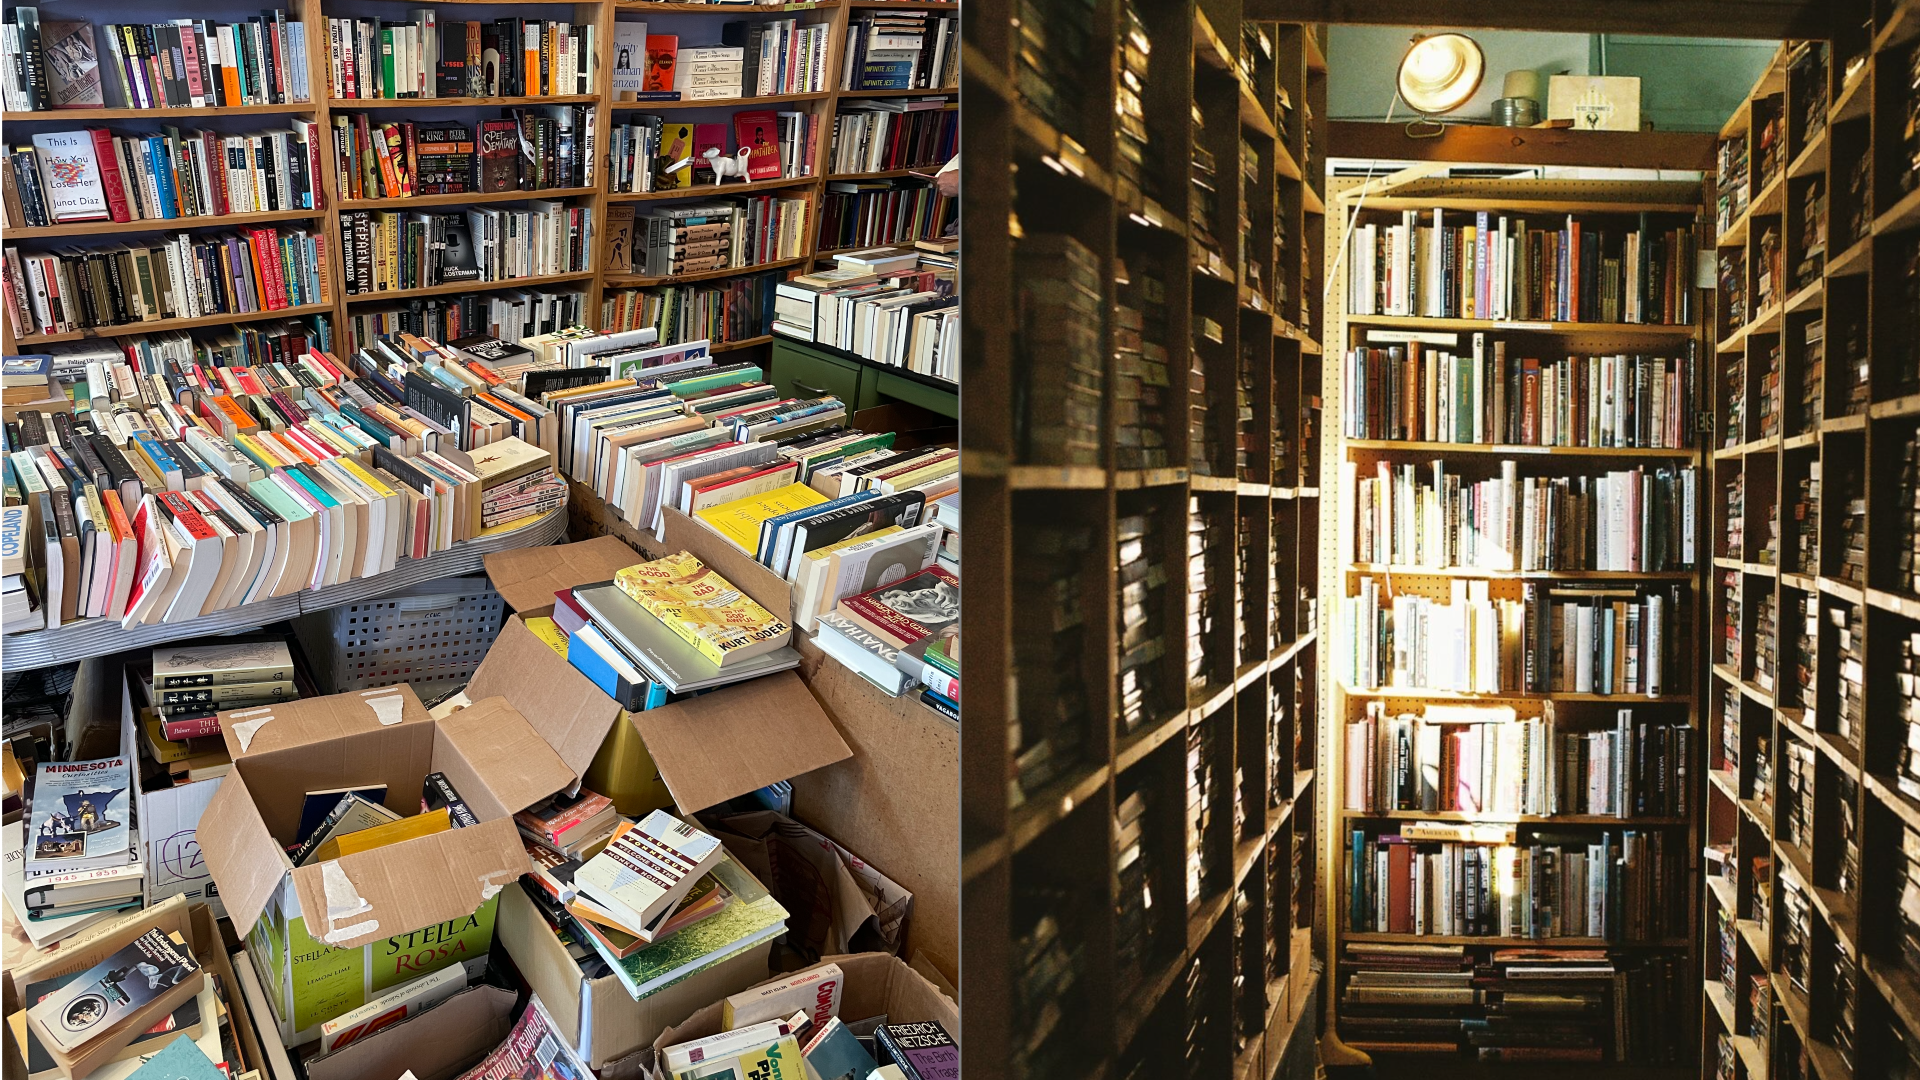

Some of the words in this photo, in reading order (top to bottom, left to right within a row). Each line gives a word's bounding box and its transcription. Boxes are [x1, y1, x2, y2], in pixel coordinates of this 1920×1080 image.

[331, 24, 339, 45] ALREADY
[198, 44, 206, 61] HARD
[613, 41, 639, 56] Purity
[27, 64, 36, 86] DeLillo
[31, 39, 47, 99] UNDERWORLD
[201, 63, 209, 81] TIMES
[57, 86, 80, 102] COCAINE
[76, 74, 95, 90] NIGHTS
[483, 122, 504, 131] STEPHEN
[503, 122, 516, 131] KING
[46, 138, 67, 147] This
[69, 137, 78, 146] Is
[426, 134, 444, 142] KING
[482, 133, 518, 154] SEMATARY
[489, 131, 506, 141] PET
[44, 156, 68, 165] How
[69, 155, 89, 164] You
[208, 135, 218, 172] ZEITOUN
[50, 180, 72, 189] Lose
[75, 179, 94, 188] Her
[53, 198, 77, 209] Junot
[613, 210, 633, 218] Robbins
[1478, 214, 1487, 235] THE
[344, 230, 352, 241] THE
[354, 212, 369, 265] STEPHEN
[1477, 236, 1486, 270] SACRED
[32, 264, 40, 291] ERDRICH
[36, 268, 44, 287] LOUISE
[357, 267, 369, 294] KING
[85, 357, 95, 365] Up
[809, 514, 834, 527] JOHN
[836, 510, 847, 519] LE
[1, 509, 23, 557] COPELAND
[638, 569, 671, 579] GOOD
[691, 581, 706, 589] THE
[693, 585, 715, 597] BAD
[725, 616, 756, 624] AWFUL
[711, 635, 726, 643] MOVIE
[718, 636, 750, 652] KURT
[750, 623, 788, 641] LODER
[822, 612, 899, 664] ONATHAN
[1526, 650, 1534, 683] CUSTER
[173, 727, 191, 735] Palmer
[198, 719, 216, 728] THE
[199, 727, 212, 735] OF
[45, 758, 124, 774] MINNESOTA
[61, 769, 109, 779] Curiosities
[1421, 828, 1454, 837] AMERICAN
[628, 837, 686, 872] VONNEGUT
[646, 836, 683, 858] KURT
[607, 851, 640, 873] MONKEY
[640, 871, 668, 888] HOUSE
[617, 844, 651, 866] WELCOME
[650, 863, 661, 872] TO
[661, 869, 678, 881] THE
[47, 873, 79, 884] 1945
[88, 868, 119, 879] 1959
[46, 950, 59, 959] The
[60, 940, 84, 952] Singular
[84, 935, 96, 943] Life
[96, 927, 111, 937] Story
[111, 922, 119, 931] of
[118, 914, 141, 925] Heedless
[142, 901, 167, 915] Hopalong
[385, 912, 480, 956] STELLA
[156, 935, 182, 962] Endangered
[179, 956, 197, 973] Planet
[293, 946, 331, 966] STELLA
[394, 938, 468, 976] ROSA
[306, 970, 335, 986] LEMON
[335, 964, 351, 977] LIME
[428, 976, 441, 986] The
[789, 973, 821, 987] COMPULSION
[399, 991, 407, 999] of
[406, 981, 429, 996] Labyrinth
[760, 989, 774, 997] LEVIN
[773, 984, 788, 993] MEYER
[1375, 991, 1401, 1000] NATIVE
[1404, 992, 1444, 1000] AMERICAN
[320, 998, 350, 1016] CONTE
[379, 993, 400, 1006] Solitude
[349, 1010, 360, 1020] Paz
[361, 1004, 378, 1015] Octavio
[519, 1010, 548, 1059] Greatest
[887, 1022, 940, 1038] FRIEDRICH
[895, 1032, 951, 1048] NIETZSCHE
[484, 1045, 524, 1080] Albums
[485, 1053, 500, 1068] they
[912, 1051, 934, 1064] The
[933, 1049, 958, 1062] Birth
[921, 1068, 932, 1080] of
